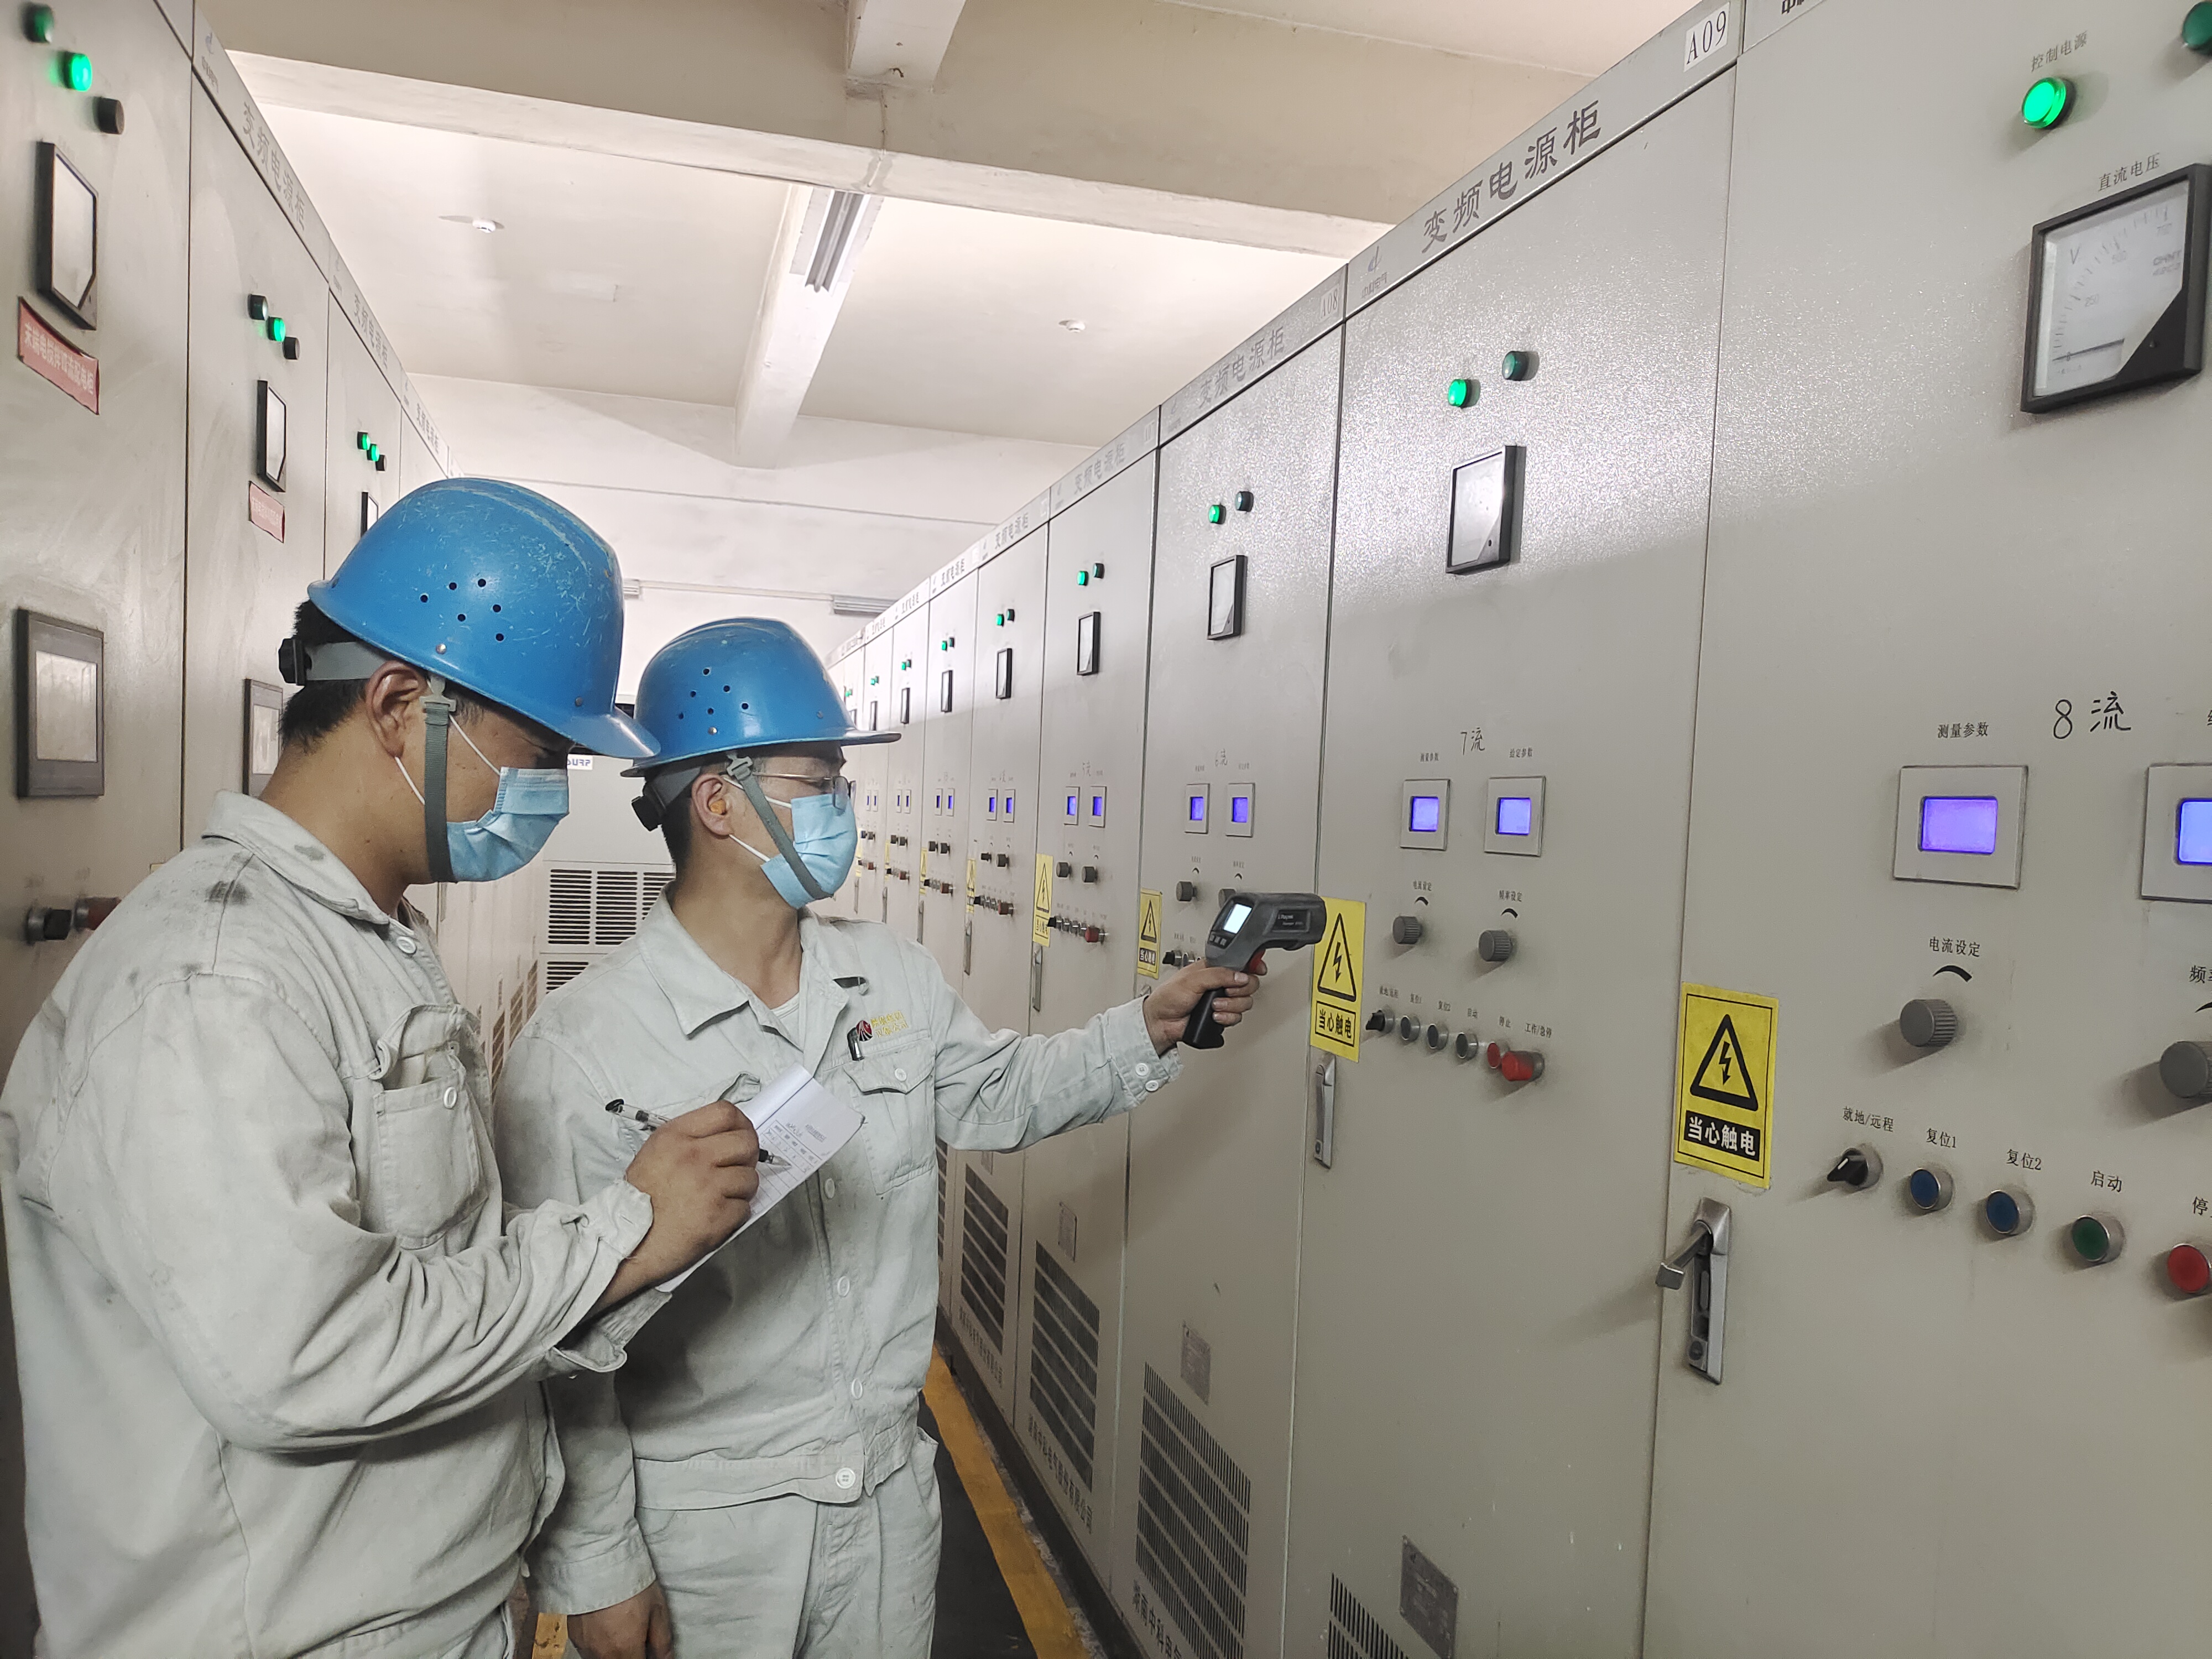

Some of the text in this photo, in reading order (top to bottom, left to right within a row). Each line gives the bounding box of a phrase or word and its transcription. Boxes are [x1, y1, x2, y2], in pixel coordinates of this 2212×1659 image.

[1687, 11, 1726, 65] A09
[2031, 30, 2088, 72] 控制电源
[242, 101, 305, 231] 变频电源柜
[1422, 100, 1601, 253] 变频电源柜
[2098, 153, 2160, 191] 直流电压
[2070, 245, 2080, 264] V
[1198, 326, 1285, 409] 变频电源柜
[2053, 691, 2131, 739] 8流
[1460, 727, 1485, 756] 7流
[1937, 722, 1989, 738] 测量参数
[1928, 937, 1981, 957] 电流设定
[2189, 965, 2212, 983] 频
[1318, 1009, 1352, 1039] 当心触电
[1842, 1106, 1894, 1133] 就地/远程
[1688, 1116, 1756, 1156] 当心触电
[1926, 1128, 1957, 1149] 复位1
[2006, 1149, 2042, 1171] 复位2
[2091, 1170, 2122, 1192] 启动
[2193, 1196, 2212, 1218] 停
